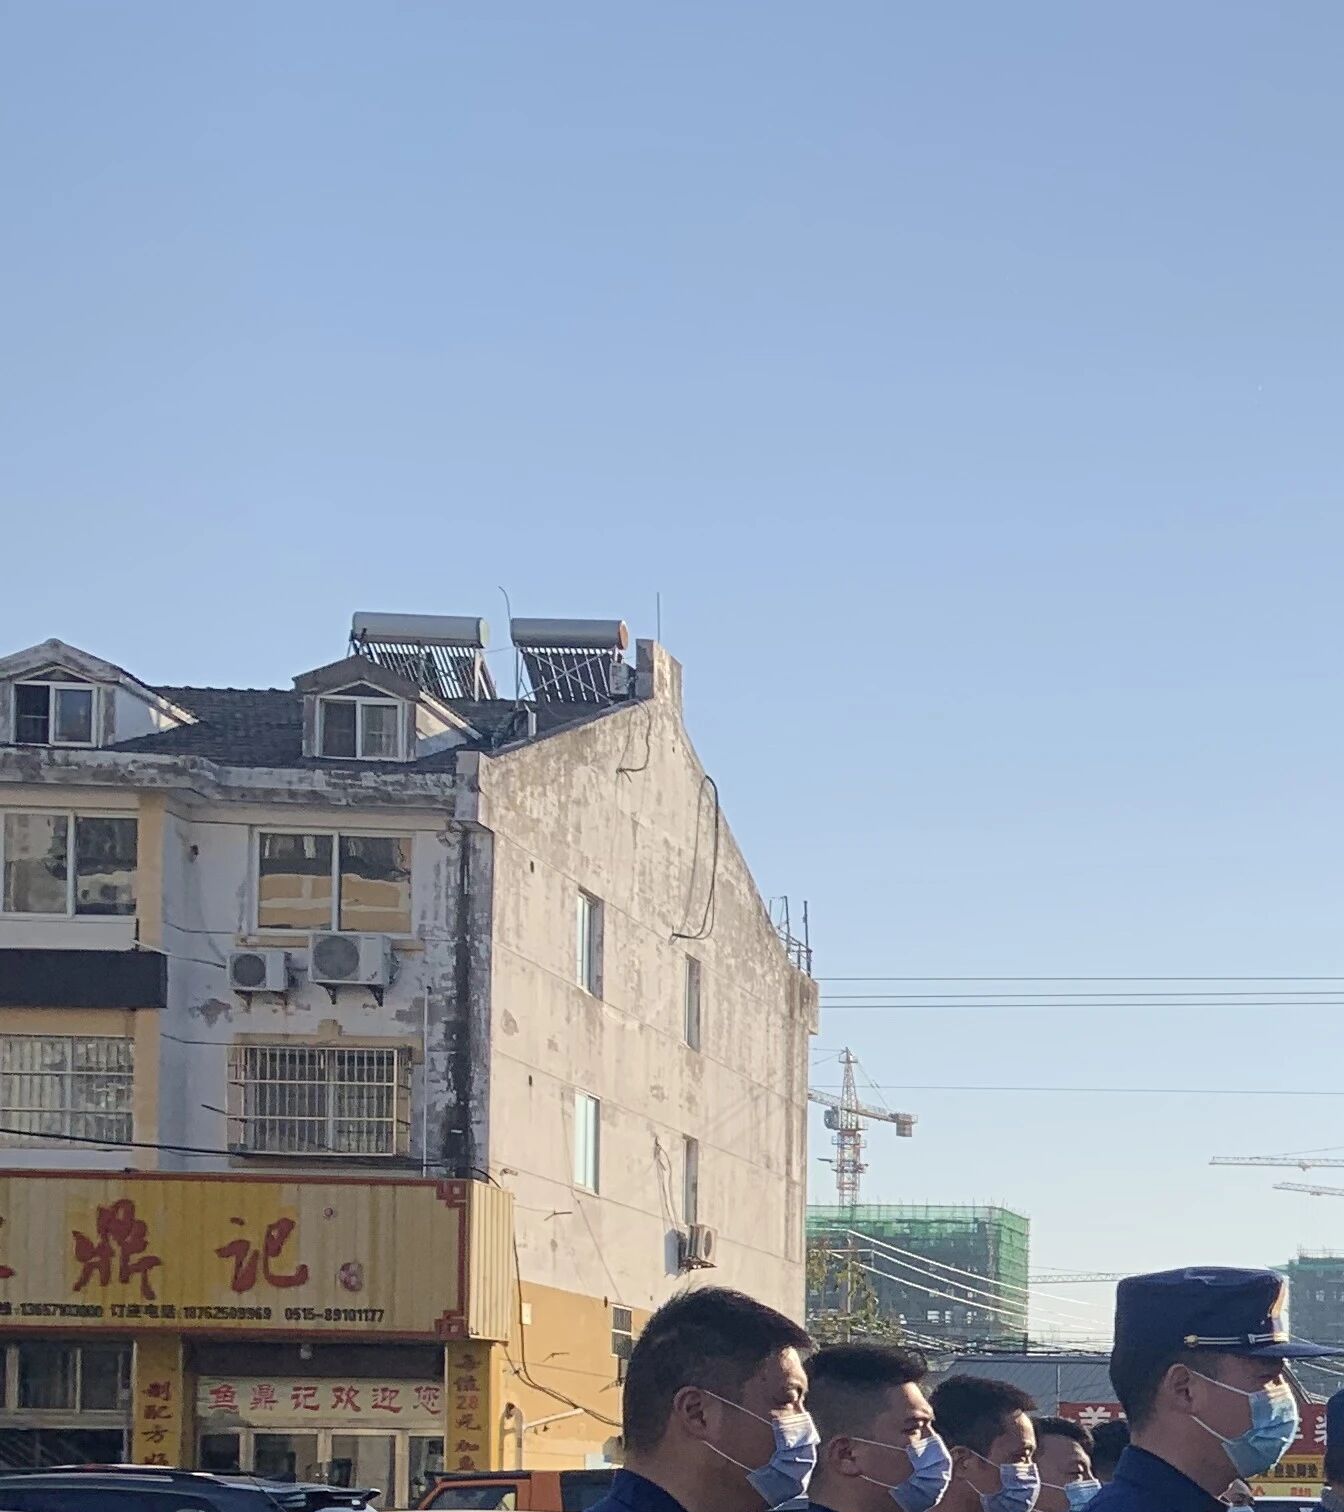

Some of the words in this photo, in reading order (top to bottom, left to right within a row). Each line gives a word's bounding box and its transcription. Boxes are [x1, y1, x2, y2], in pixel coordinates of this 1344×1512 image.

[0, 1199, 310, 1300] 鼎记
[207, 1383, 442, 1415] 鱼鼎记欢迎您
